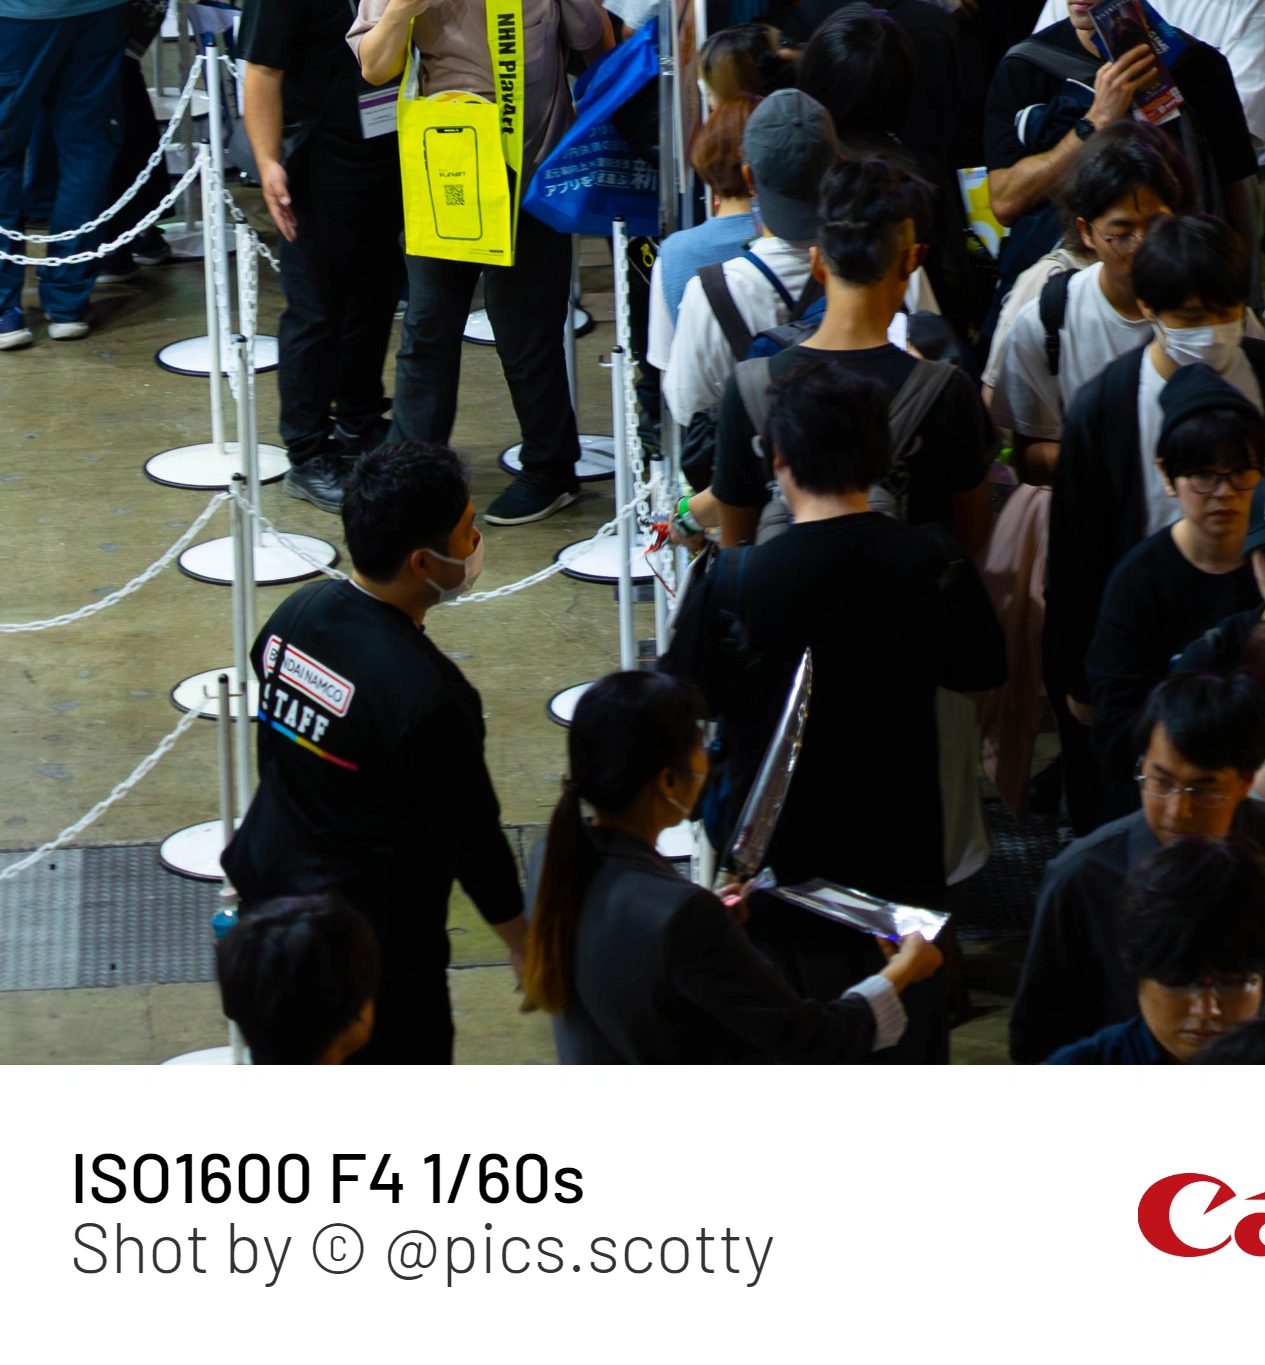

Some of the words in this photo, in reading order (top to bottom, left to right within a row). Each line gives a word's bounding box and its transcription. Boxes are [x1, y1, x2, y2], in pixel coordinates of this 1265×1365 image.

[497, 12, 517, 56] NHN
[498, 60, 518, 136] PlayArt
[269, 647, 306, 680] BNDAI
[304, 669, 343, 703] NAMCO
